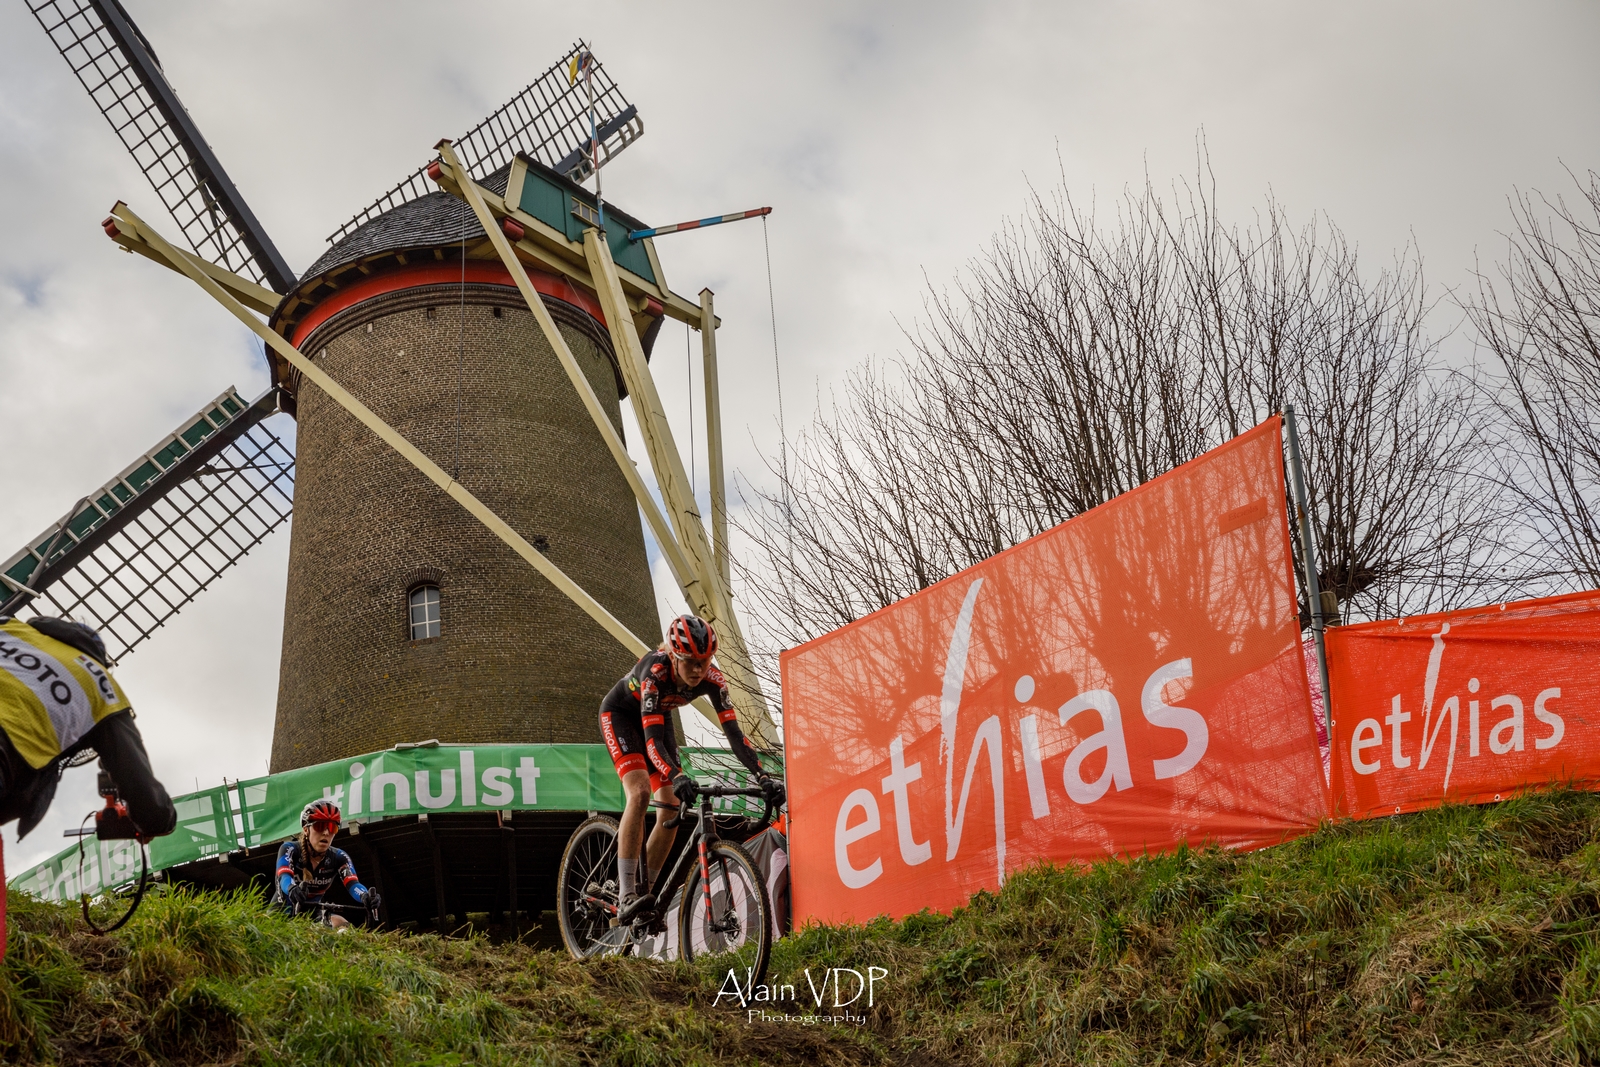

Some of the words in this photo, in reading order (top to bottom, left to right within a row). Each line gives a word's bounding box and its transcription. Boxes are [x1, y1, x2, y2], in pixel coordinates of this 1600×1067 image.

[85, 661, 115, 700] UCI
[645, 697, 654, 708] 6
[834, 577, 1209, 890] ethias
[1351, 622, 1565, 797] ethias
